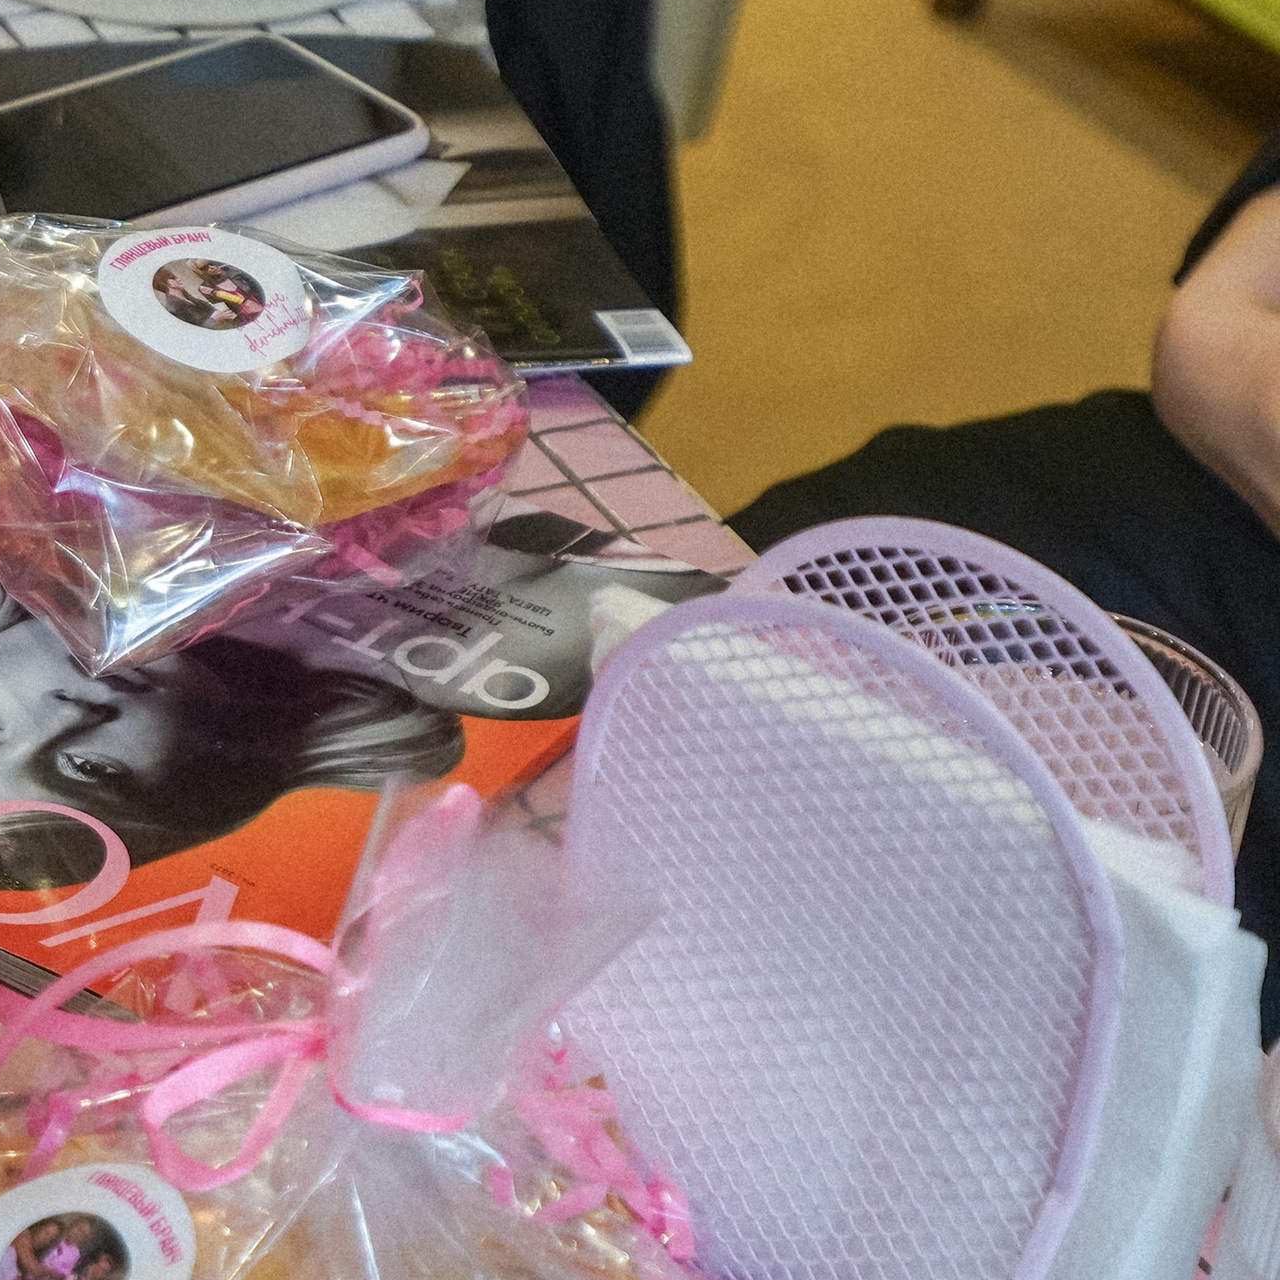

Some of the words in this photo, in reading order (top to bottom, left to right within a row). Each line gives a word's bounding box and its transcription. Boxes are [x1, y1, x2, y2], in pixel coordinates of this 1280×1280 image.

[110, 234, 171, 271] ГЛЯНЦЕВЫЙ
[170, 231, 212, 246] БРАНЧ
[395, 599, 473, 639] Творим
